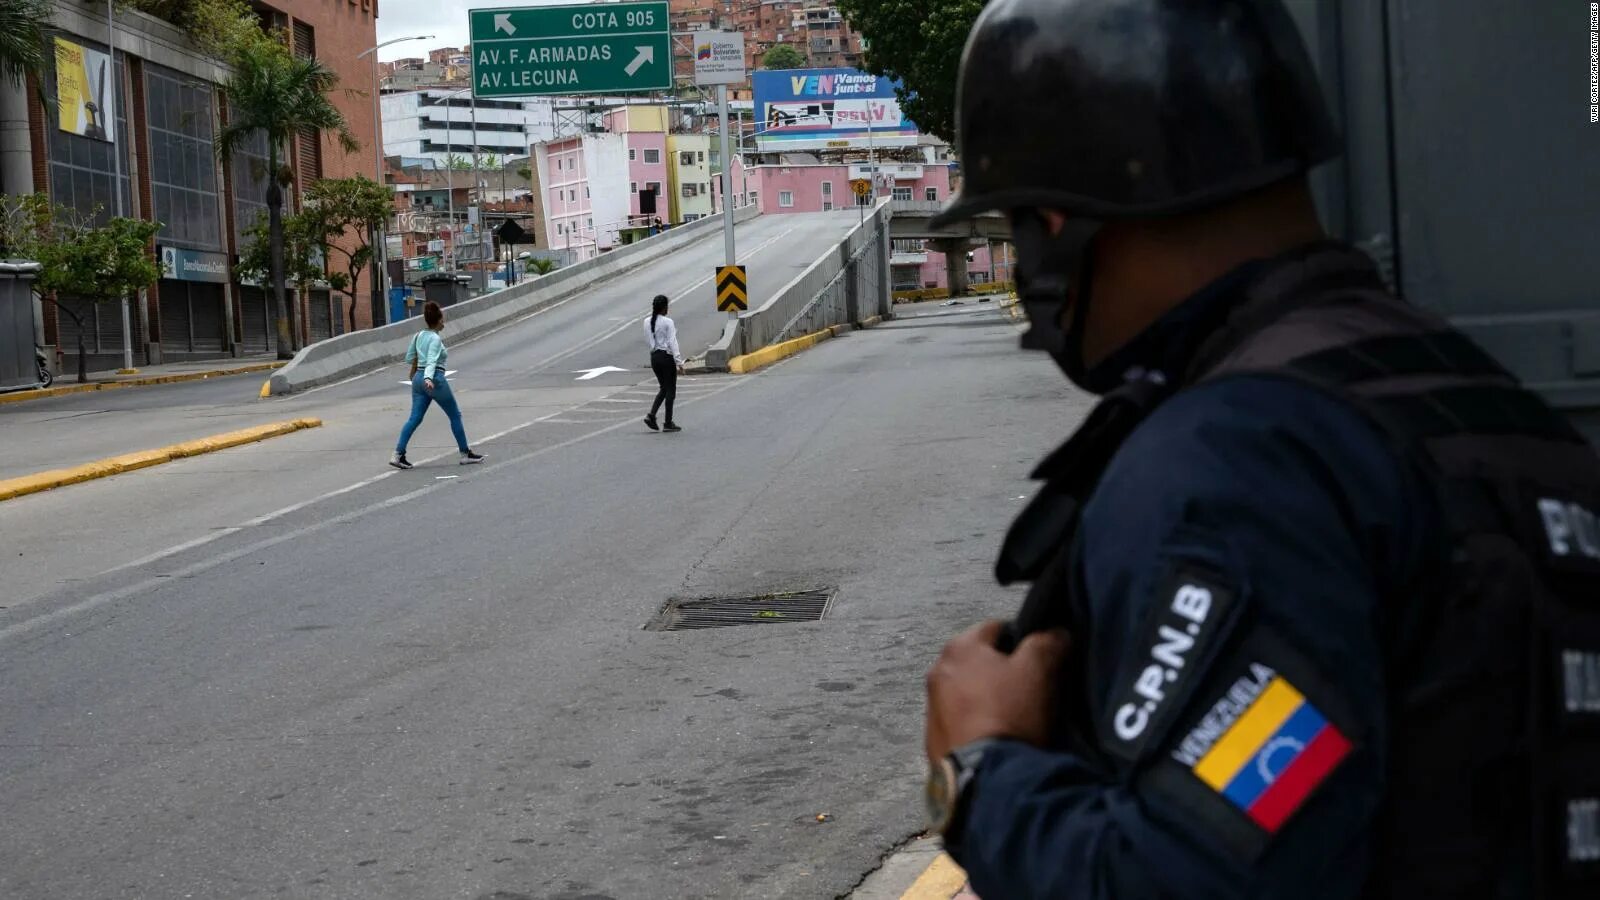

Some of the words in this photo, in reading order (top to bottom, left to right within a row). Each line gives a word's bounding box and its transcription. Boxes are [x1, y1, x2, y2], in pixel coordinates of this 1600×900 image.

[572, 12, 618, 29] COTA
[626, 11, 654, 27] 905
[479, 49, 506, 65] AV.
[509, 48, 524, 64] F.
[528, 44, 612, 63] ARMADAS
[480, 72, 507, 88] AV.
[511, 69, 579, 87] LECUNA
[791, 74, 834, 96] VEN
[1113, 583, 1212, 741] C.P.N.B
[1172, 662, 1276, 767] VENEZUELA
